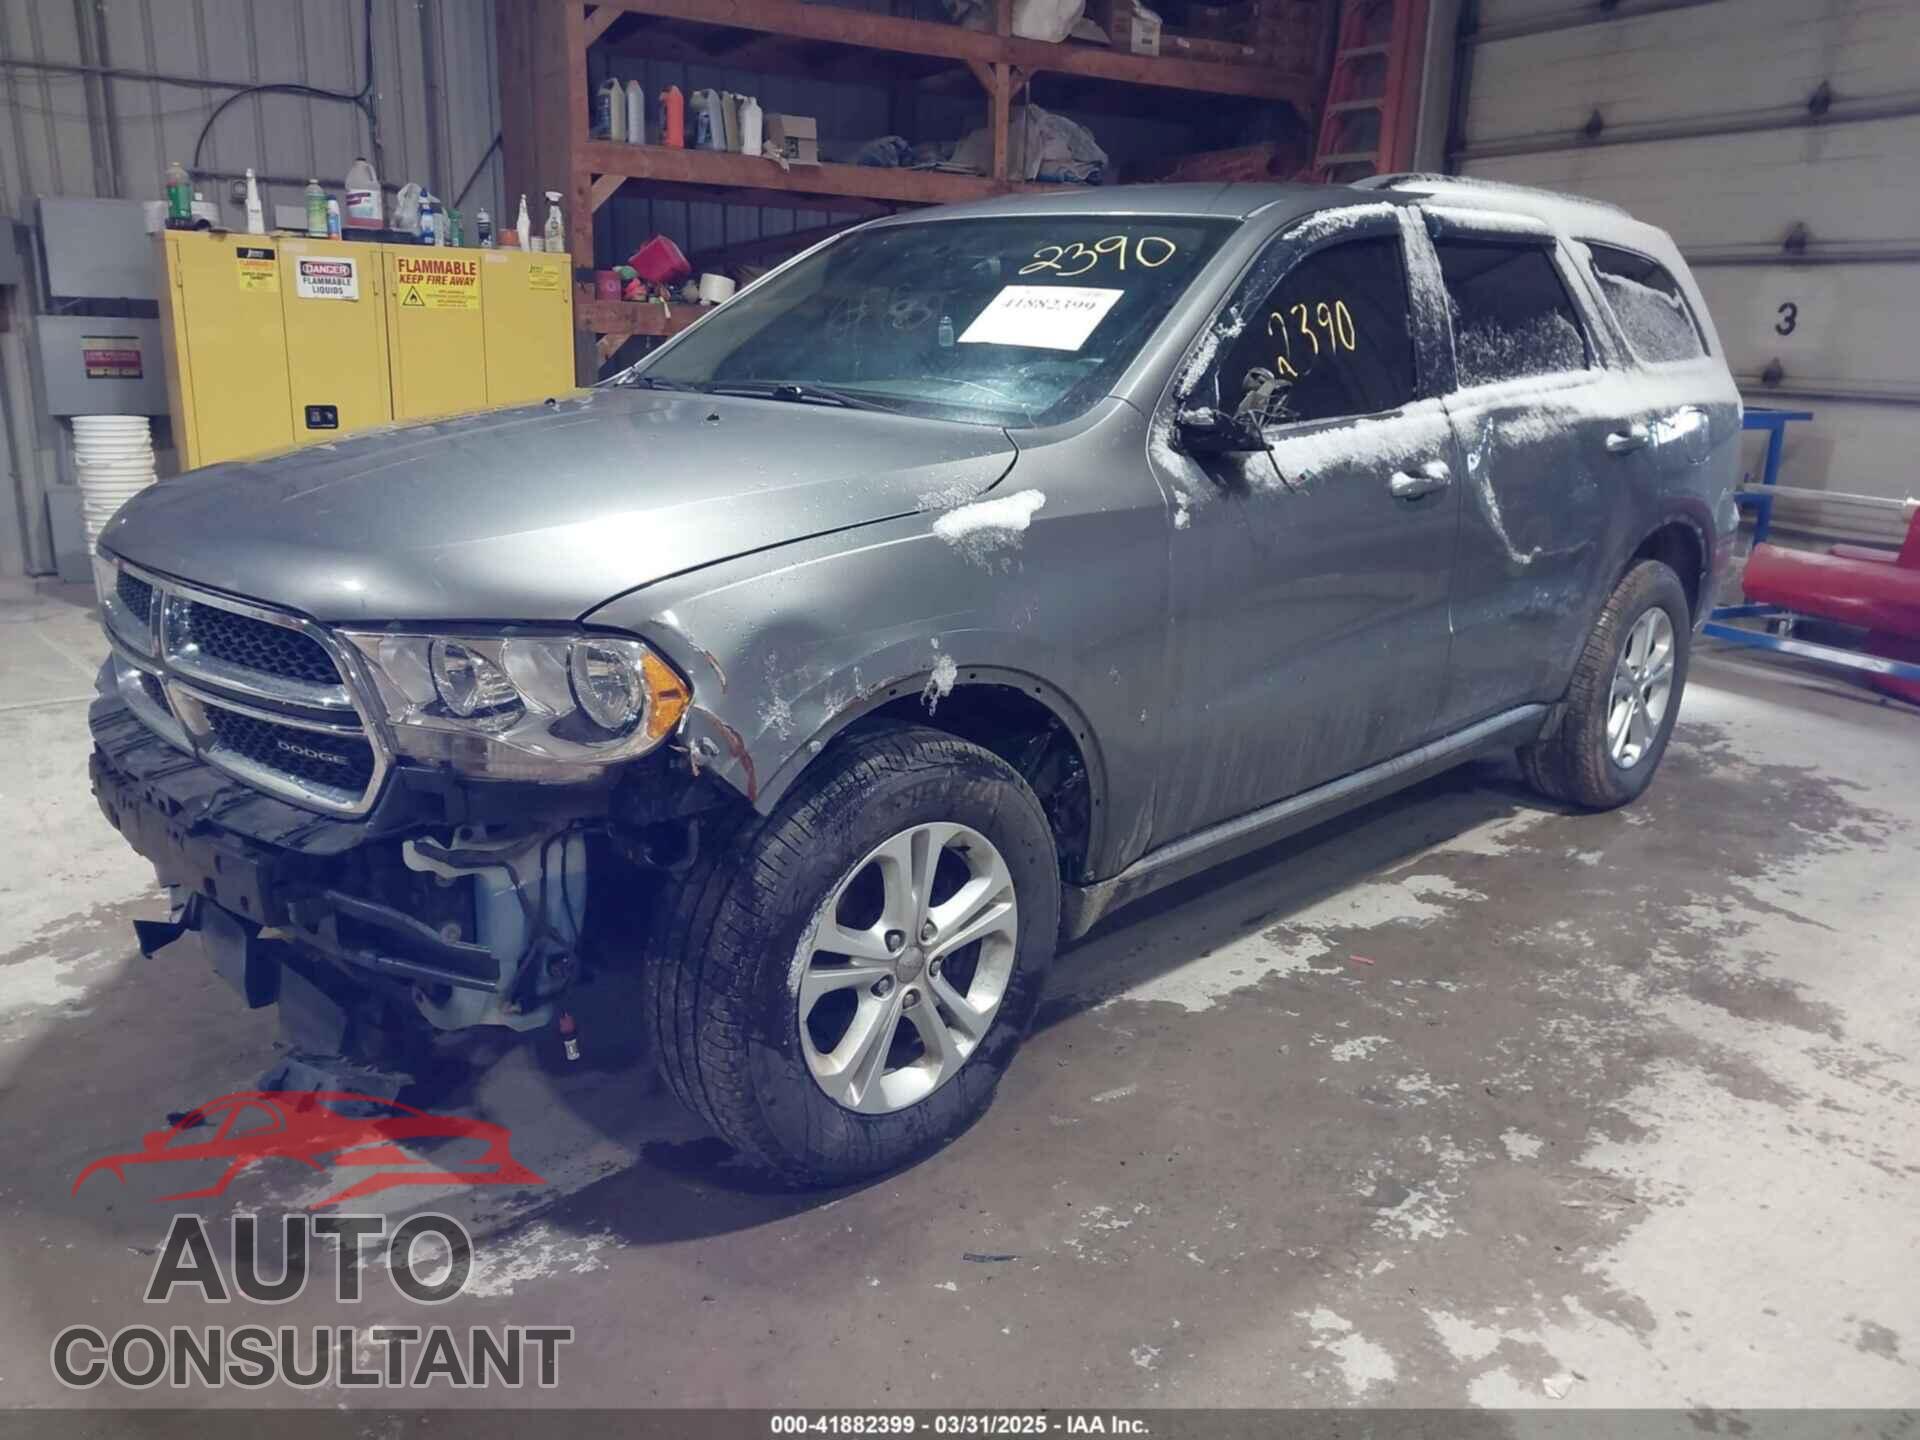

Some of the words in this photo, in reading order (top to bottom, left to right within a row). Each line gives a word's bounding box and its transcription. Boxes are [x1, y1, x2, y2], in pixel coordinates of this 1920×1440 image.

[1018, 235, 1176, 276] 2390
[306, 264, 346, 274] DANGER
[398, 258, 477, 276] FLAMMABLE
[303, 277, 352, 287] FLAMMABLE
[400, 274, 424, 285] KEEP
[426, 275, 449, 286] FIRE
[449, 276, 476, 287] AWAY
[312, 285, 344, 295] LIQUIDS
[1776, 302, 1798, 336] 3
[1268, 300, 1356, 377] 2390
[277, 740, 350, 765] DODGE
